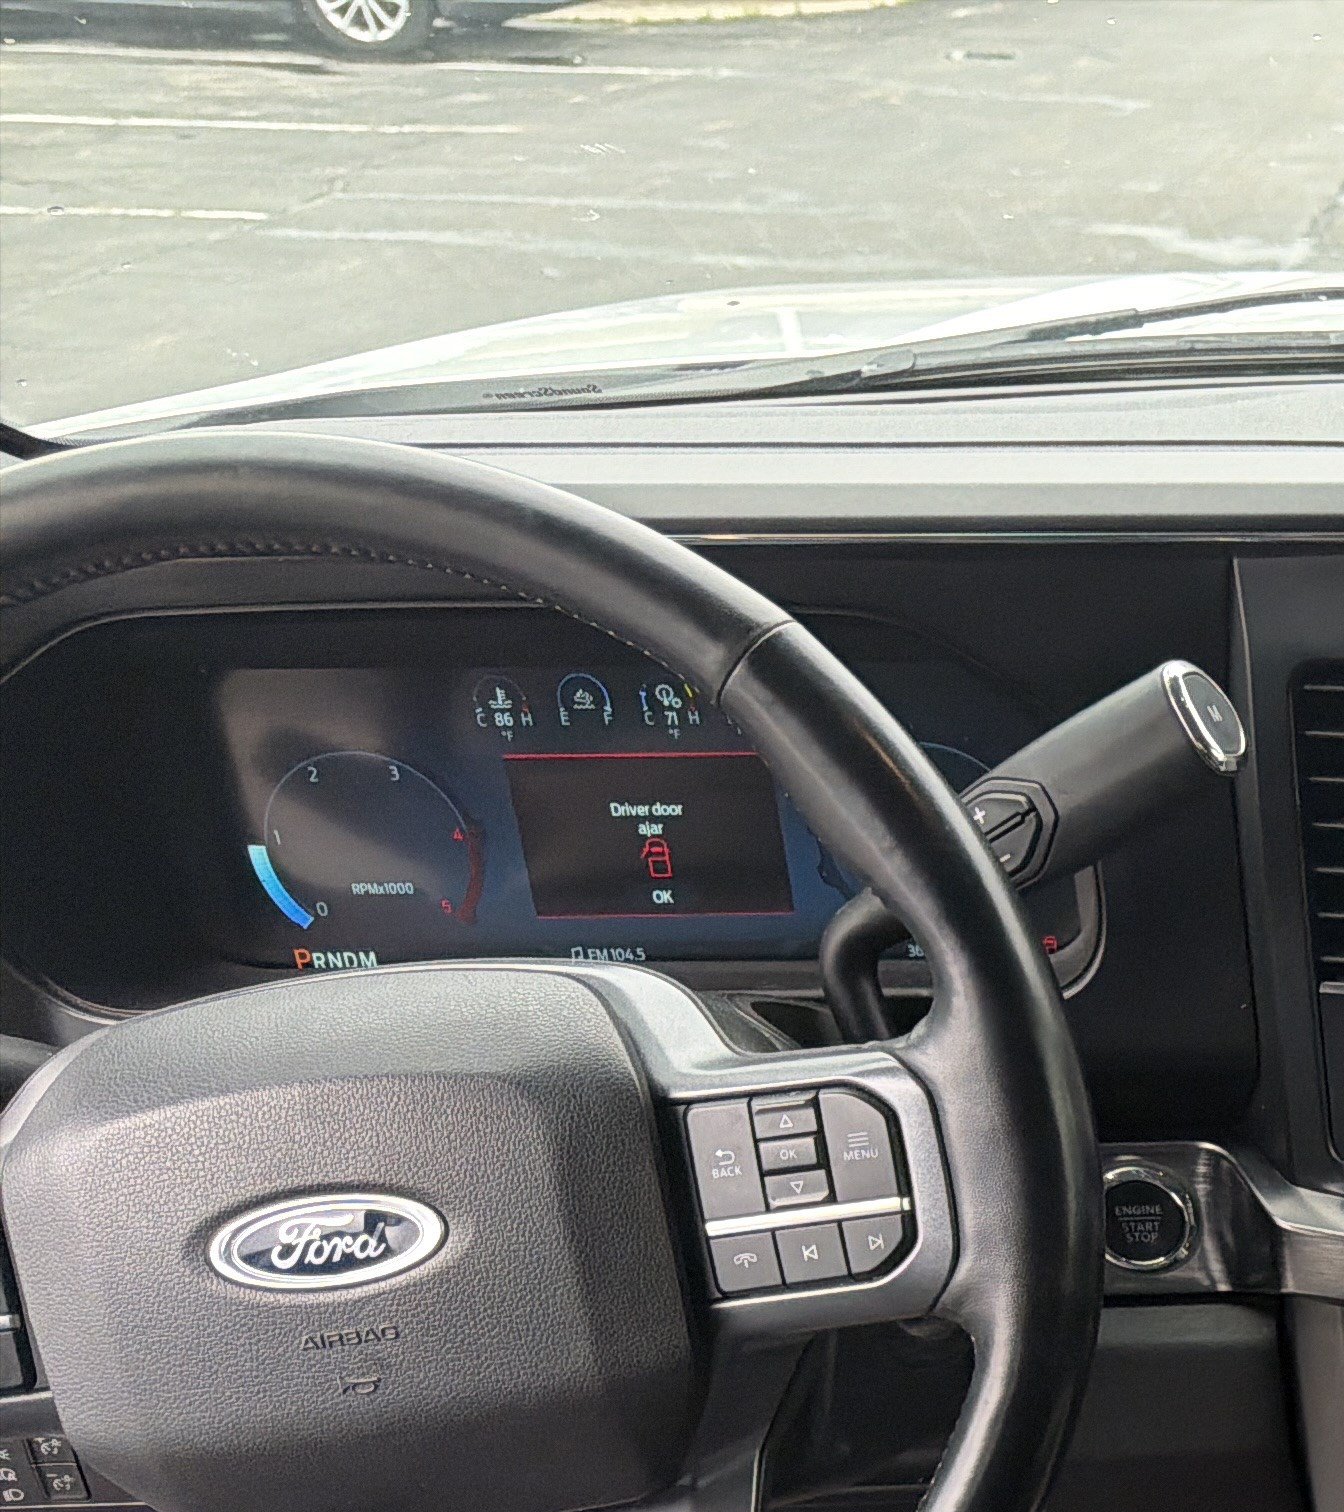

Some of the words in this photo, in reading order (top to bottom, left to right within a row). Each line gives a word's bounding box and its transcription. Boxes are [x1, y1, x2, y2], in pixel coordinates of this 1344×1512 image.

[476, 711, 488, 727] C
[494, 712, 514, 727] 86
[521, 711, 533, 727] H
[560, 711, 571, 726] E
[603, 711, 613, 726] F
[644, 711, 655, 726] C
[664, 710, 679, 726] 71
[688, 710, 700, 725] H
[307, 766, 319, 783] 2
[389, 765, 400, 781] 3
[609, 802, 649, 817] Driver
[651, 802, 683, 816] door
[452, 827, 464, 842] 4
[637, 820, 664, 837] ajar
[273, 829, 282, 845] 1
[351, 882, 415, 896] RPMx1000
[652, 889, 675, 904] OK
[316, 901, 328, 917] 0
[587, 948, 609, 962] FM
[610, 947, 646, 961] 104.5
[779, 1149, 798, 1161] OK
[843, 1149, 879, 1162] MENU
[711, 1165, 743, 1179] BACK
[1114, 1204, 1163, 1216] ENGINE
[1121, 1221, 1160, 1233] START
[271, 1214, 386, 1269] Ford
[1125, 1231, 1159, 1244] STOP
[301, 1324, 400, 1351] AIRBAG
